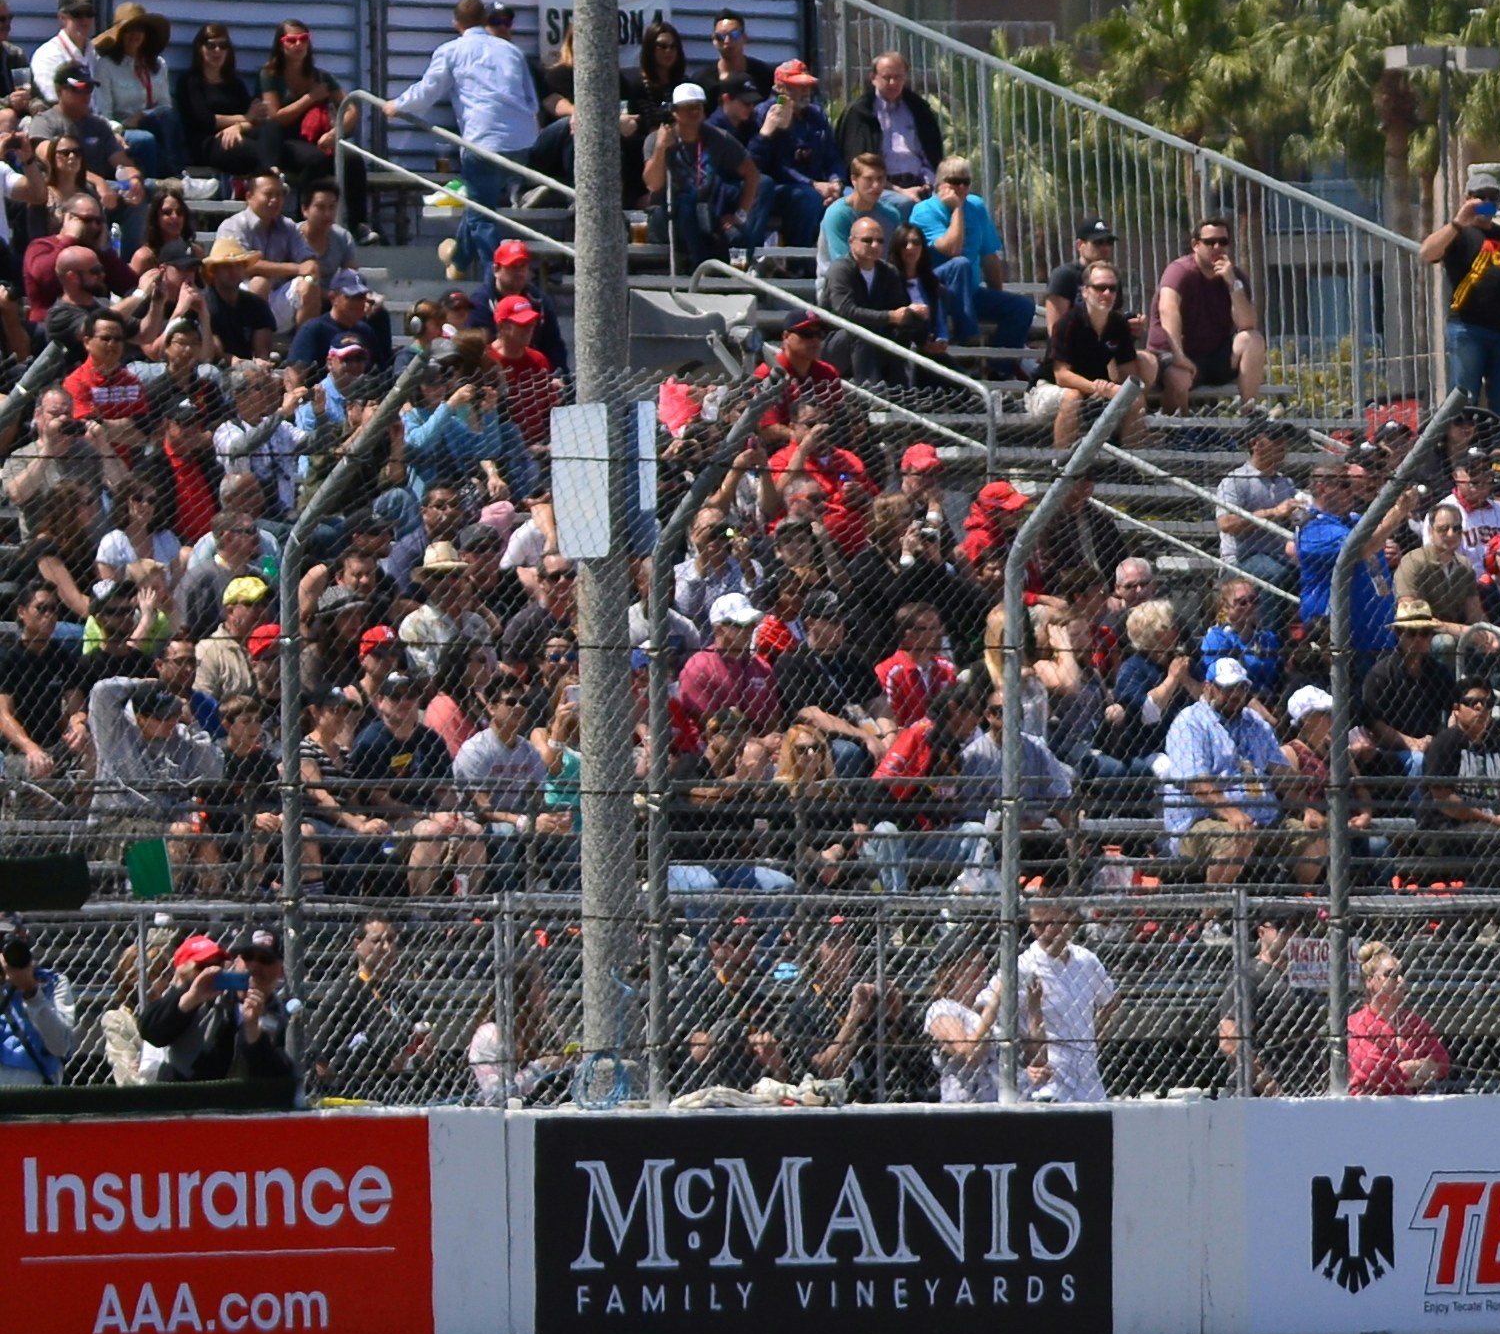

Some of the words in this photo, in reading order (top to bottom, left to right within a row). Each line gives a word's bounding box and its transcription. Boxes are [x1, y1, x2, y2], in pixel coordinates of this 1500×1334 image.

[1291, 941, 1357, 963] NATIOL
[22, 1156, 392, 1233] Insurance
[571, 1157, 1082, 1270] McMANIS
[93, 1281, 328, 1334] AAA.com
[577, 1282, 752, 1314] FAMILY
[799, 1274, 1076, 1308] VINEYARDS
[1424, 1301, 1449, 1315] Enjoy
